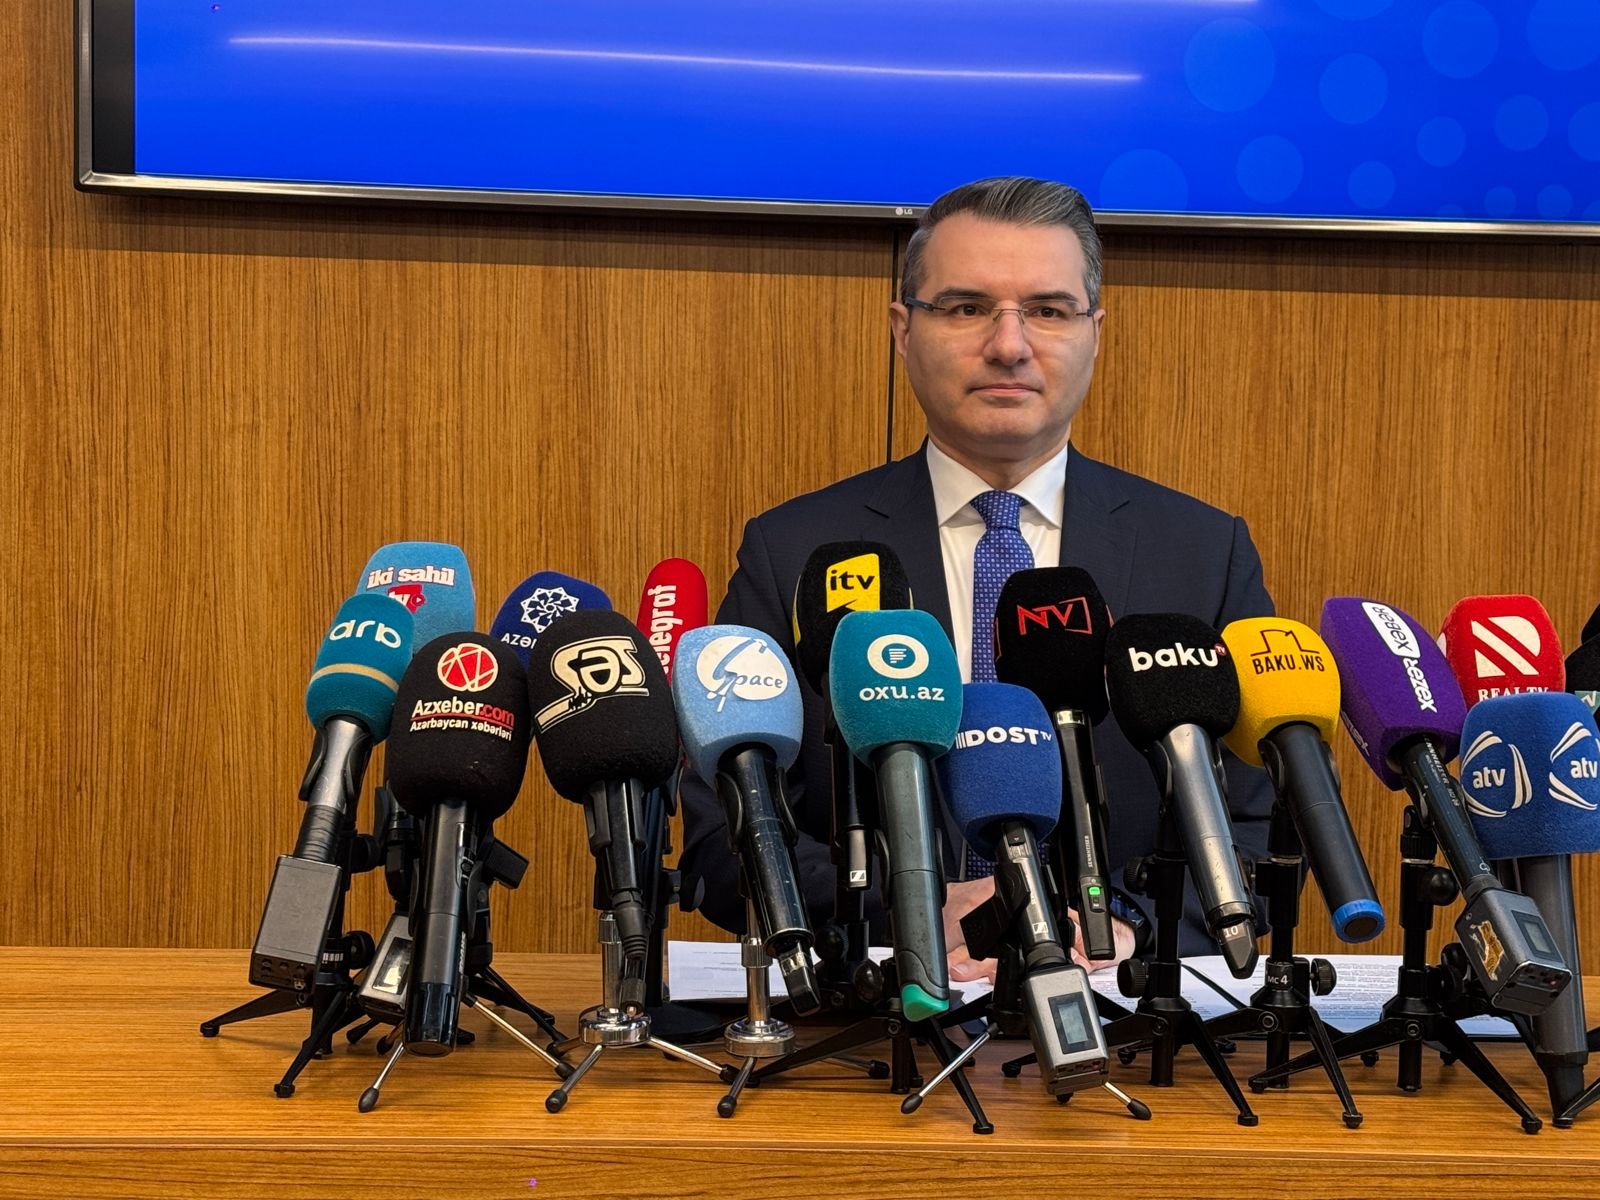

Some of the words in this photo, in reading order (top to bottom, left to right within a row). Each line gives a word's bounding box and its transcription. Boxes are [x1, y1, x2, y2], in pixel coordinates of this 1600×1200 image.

[366, 567, 395, 589] iki
[397, 566, 455, 586] sahil
[830, 569, 875, 591] itv
[1128, 642, 1219, 672] baku
[1251, 653, 1325, 675] BAKU.WS
[858, 685, 946, 702] oxu.az
[411, 696, 515, 727] Azxeber.com
[1472, 766, 1506, 789] atv
[1570, 757, 1598, 779] atv
[1224, 926, 1239, 938] 10
[1280, 974, 1289, 985] 4
